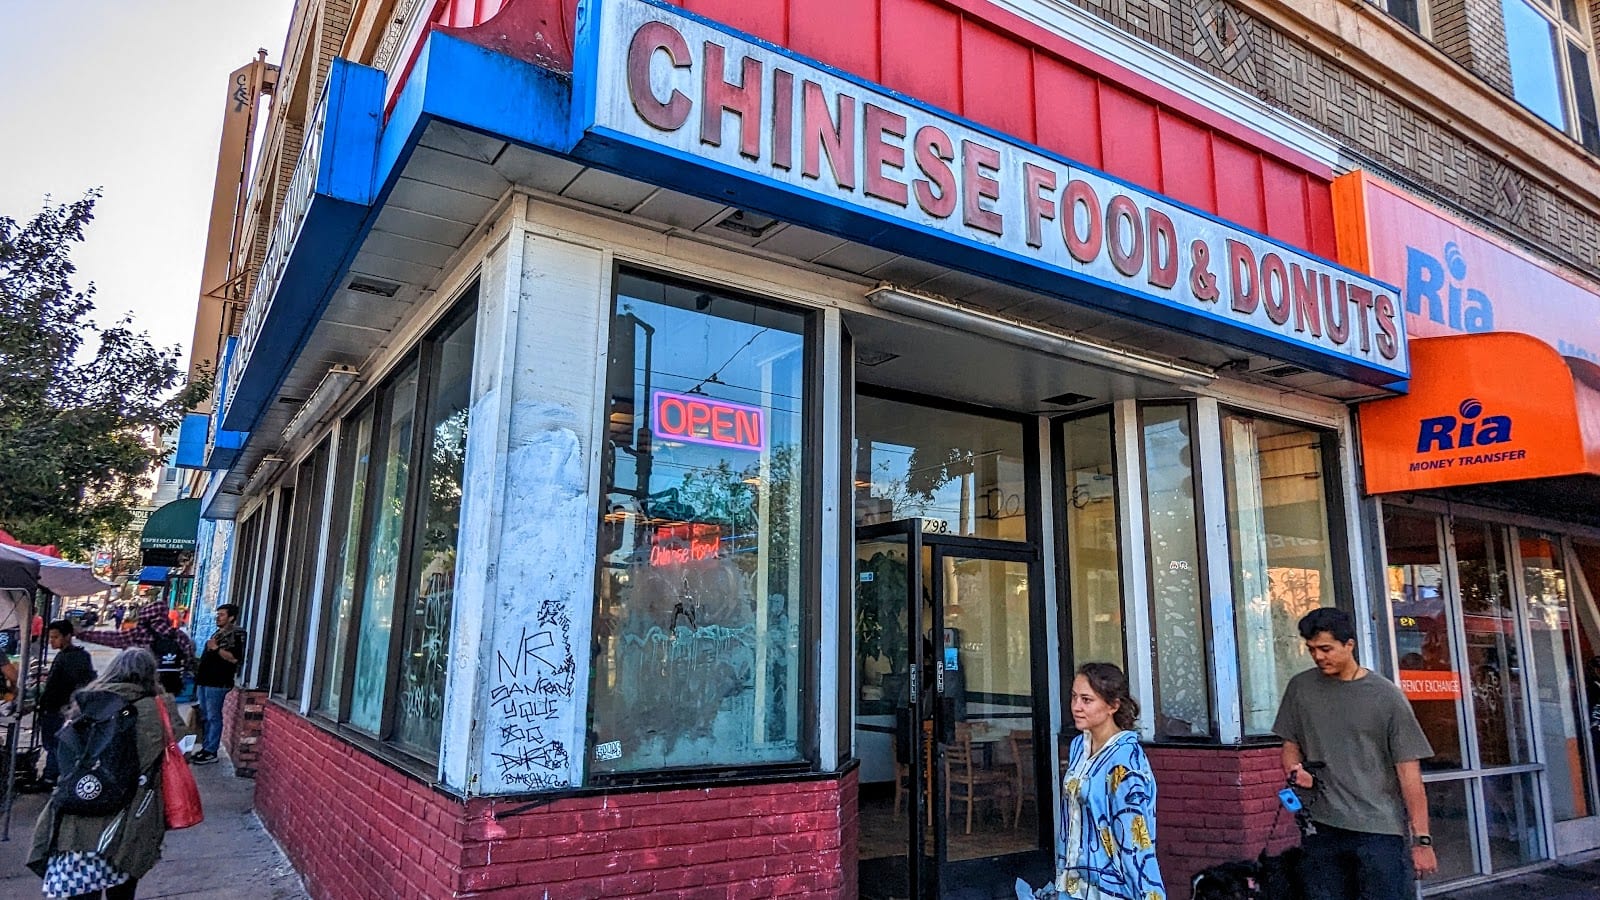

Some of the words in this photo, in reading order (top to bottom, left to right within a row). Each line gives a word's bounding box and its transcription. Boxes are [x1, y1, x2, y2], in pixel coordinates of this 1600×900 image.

[627, 20, 1003, 235] CHINESE
[1023, 161, 1178, 289] FOOD
[1190, 239, 1220, 304] &
[1226, 238, 1399, 360] DONUTS
[1406, 241, 1494, 333] Ria
[660, 397, 759, 446] OPEN
[1416, 398, 1513, 454] Ria
[1409, 458, 1454, 472] MONEY
[1458, 449, 1527, 467] TRANSFER
[691, 536, 719, 561] Food
[1425, 680, 1459, 693] EXCHANGE
